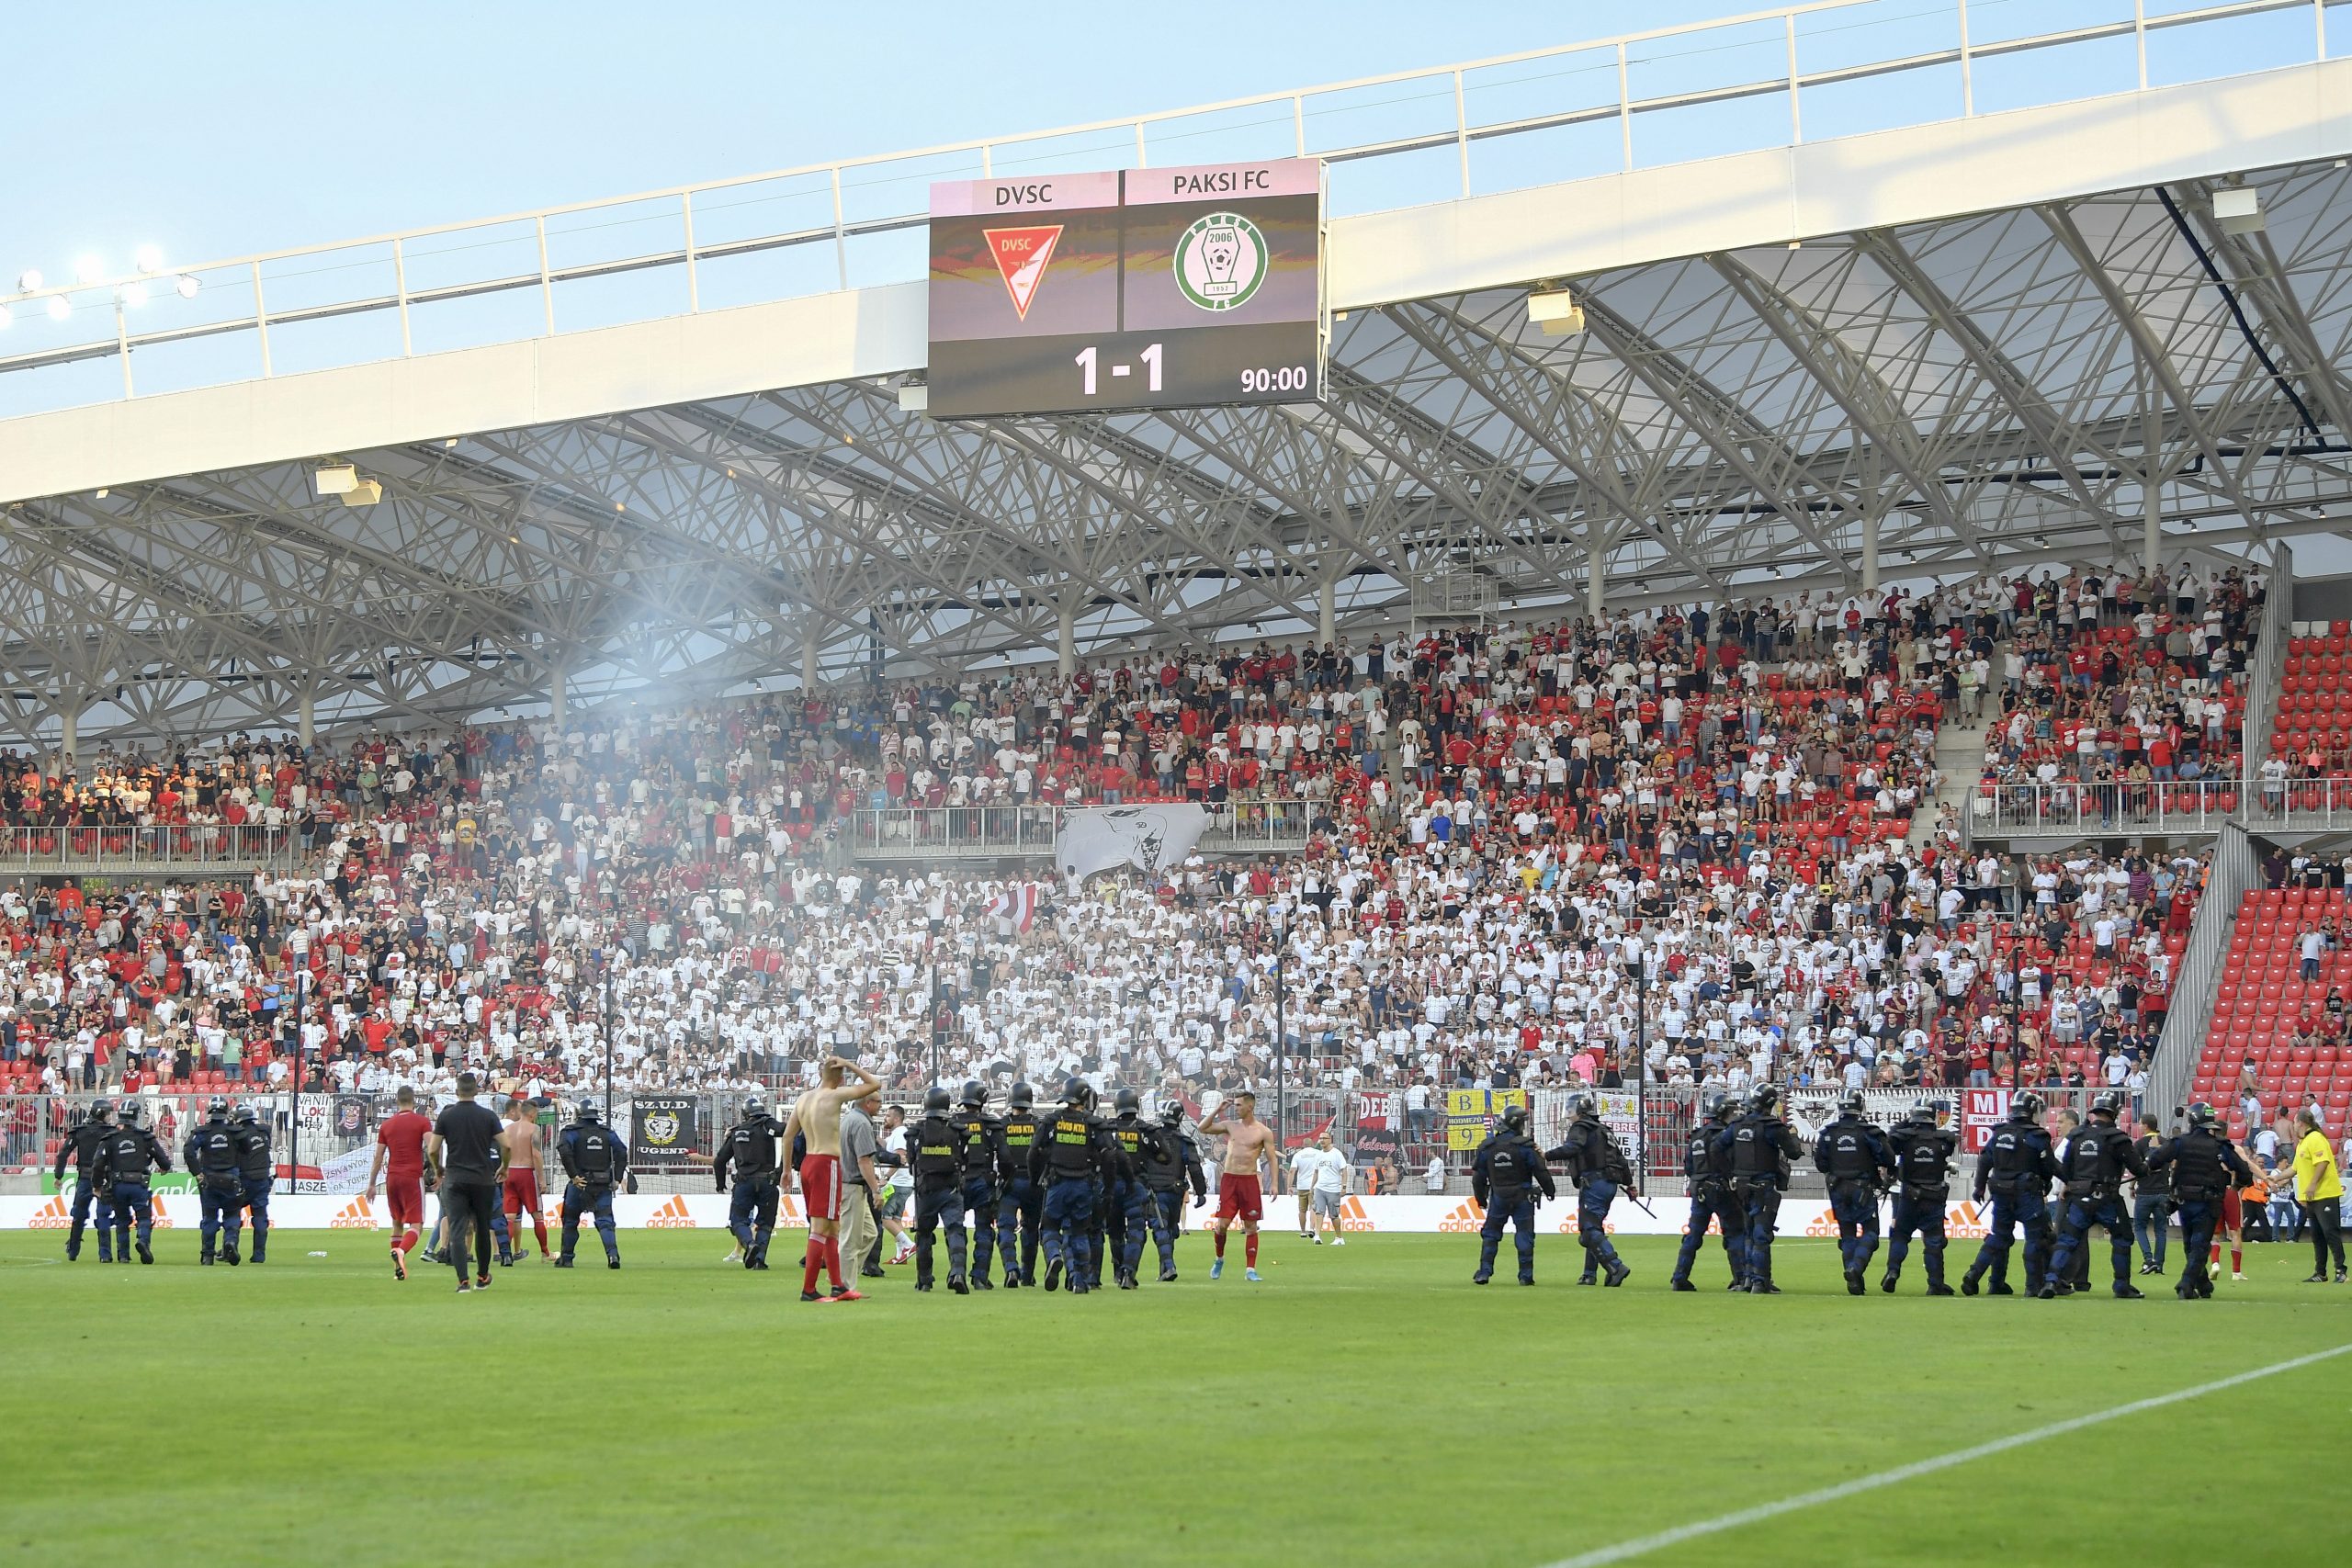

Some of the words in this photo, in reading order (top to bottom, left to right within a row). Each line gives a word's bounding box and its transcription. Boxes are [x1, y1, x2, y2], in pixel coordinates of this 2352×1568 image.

[1173, 172, 1238, 195] PAKSI
[1244, 170, 1271, 190] FC
[995, 184, 1053, 206] DVSC
[1209, 232, 1232, 243] 2006
[1001, 238, 1032, 252] DVSC
[1240, 367, 1307, 393] 90:00
[634, 1100, 691, 1110] SZ.U.D.
[1459, 1094, 1471, 1111] B
[969, 1122, 981, 1132] KTA
[1023, 1125, 1035, 1134] KTA
[1074, 1122, 1086, 1134] KTA
[1126, 1132, 1138, 1142] KTA
[1461, 1129, 1473, 1145] 9
[29, 1217, 73, 1228] adidas
[331, 1217, 379, 1228] adidas
[646, 1217, 696, 1228] adidas
[1321, 1219, 1374, 1232] aidas
[1439, 1220, 1483, 1233] adida
